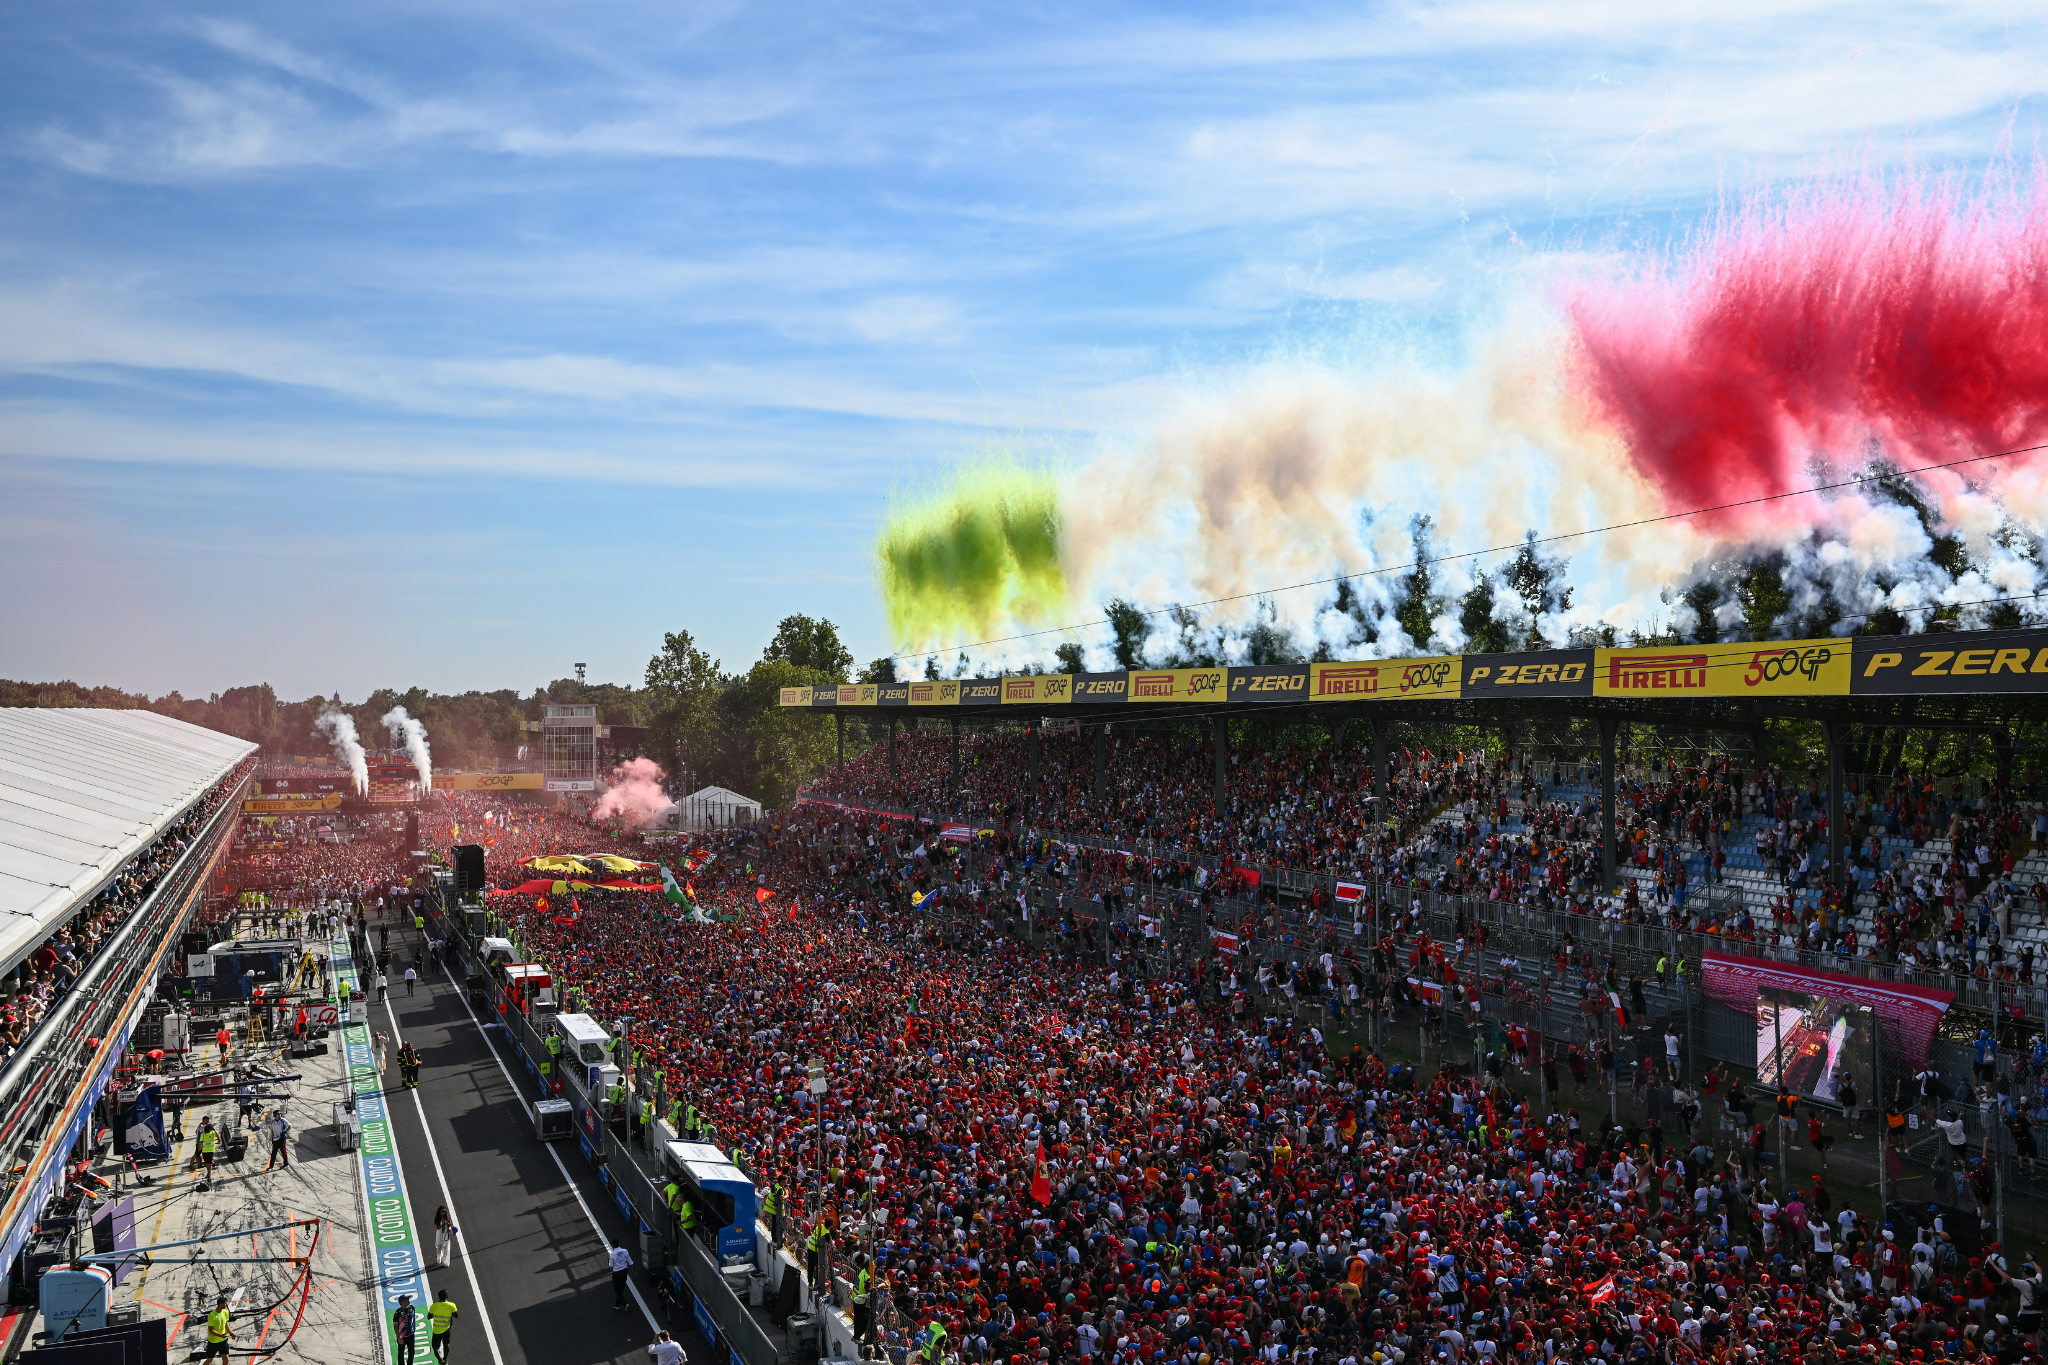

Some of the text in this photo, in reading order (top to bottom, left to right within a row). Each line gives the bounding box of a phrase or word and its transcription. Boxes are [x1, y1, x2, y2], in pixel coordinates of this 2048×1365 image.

[1468, 663, 1587, 685] P ZERO
[1609, 648, 1831, 688] PIRELLI 500GP
[1863, 652, 1902, 677] P
[1075, 680, 1126, 694] P ZERO
[1134, 674, 1220, 696] PIRELLI 500GP
[1231, 674, 1306, 691] P ZERO
[1319, 663, 1450, 694] PIRELLI 500GP
[819, 690, 836, 700] ZERO
[839, 688, 856, 702] PIRELLI
[879, 689, 907, 699] P ZERO
[912, 685, 933, 702] PIRELLI
[962, 685, 1000, 697] P ZERO
[1006, 681, 1034, 699] PIRELLI
[1730, 967, 1750, 975] The
[1752, 971, 1797, 983] Official
[1797, 980, 1842, 992] Ferrari
[1844, 988, 1897, 1003] Passion
[353, 1067, 375, 1090] aramco
[358, 1093, 380, 1119] aramco
[362, 1122, 388, 1153] aramco
[368, 1158, 396, 1194] aramco
[374, 1199, 406, 1242] aramco
[382, 1250, 419, 1303] aramco
